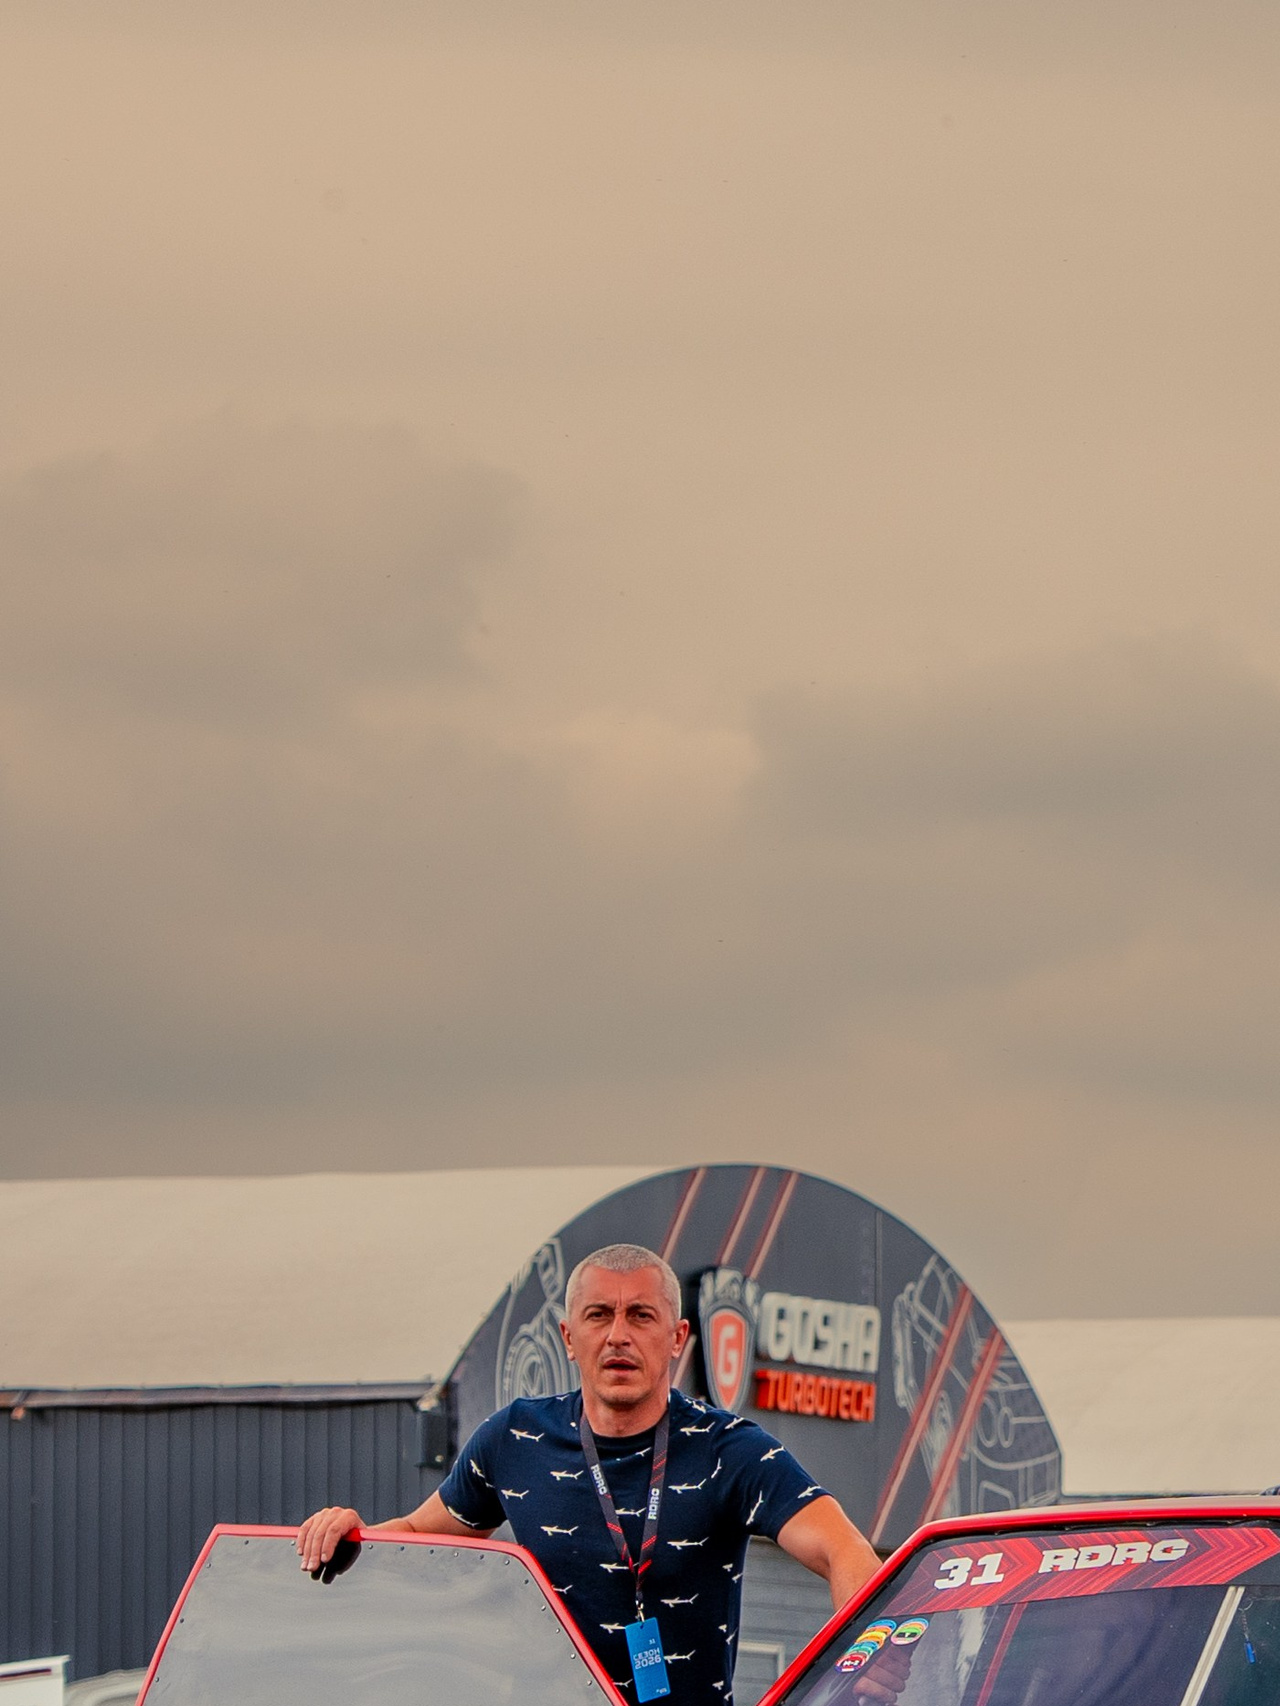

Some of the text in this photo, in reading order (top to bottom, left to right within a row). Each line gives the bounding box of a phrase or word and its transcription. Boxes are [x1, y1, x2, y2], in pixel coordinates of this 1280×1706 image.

[760, 1291, 881, 1374] GOSHA
[757, 1369, 876, 1422] TURBOTECH
[934, 1538, 1190, 1589] 31 RDRC
[633, 1647, 660, 1661] СЕЗОН
